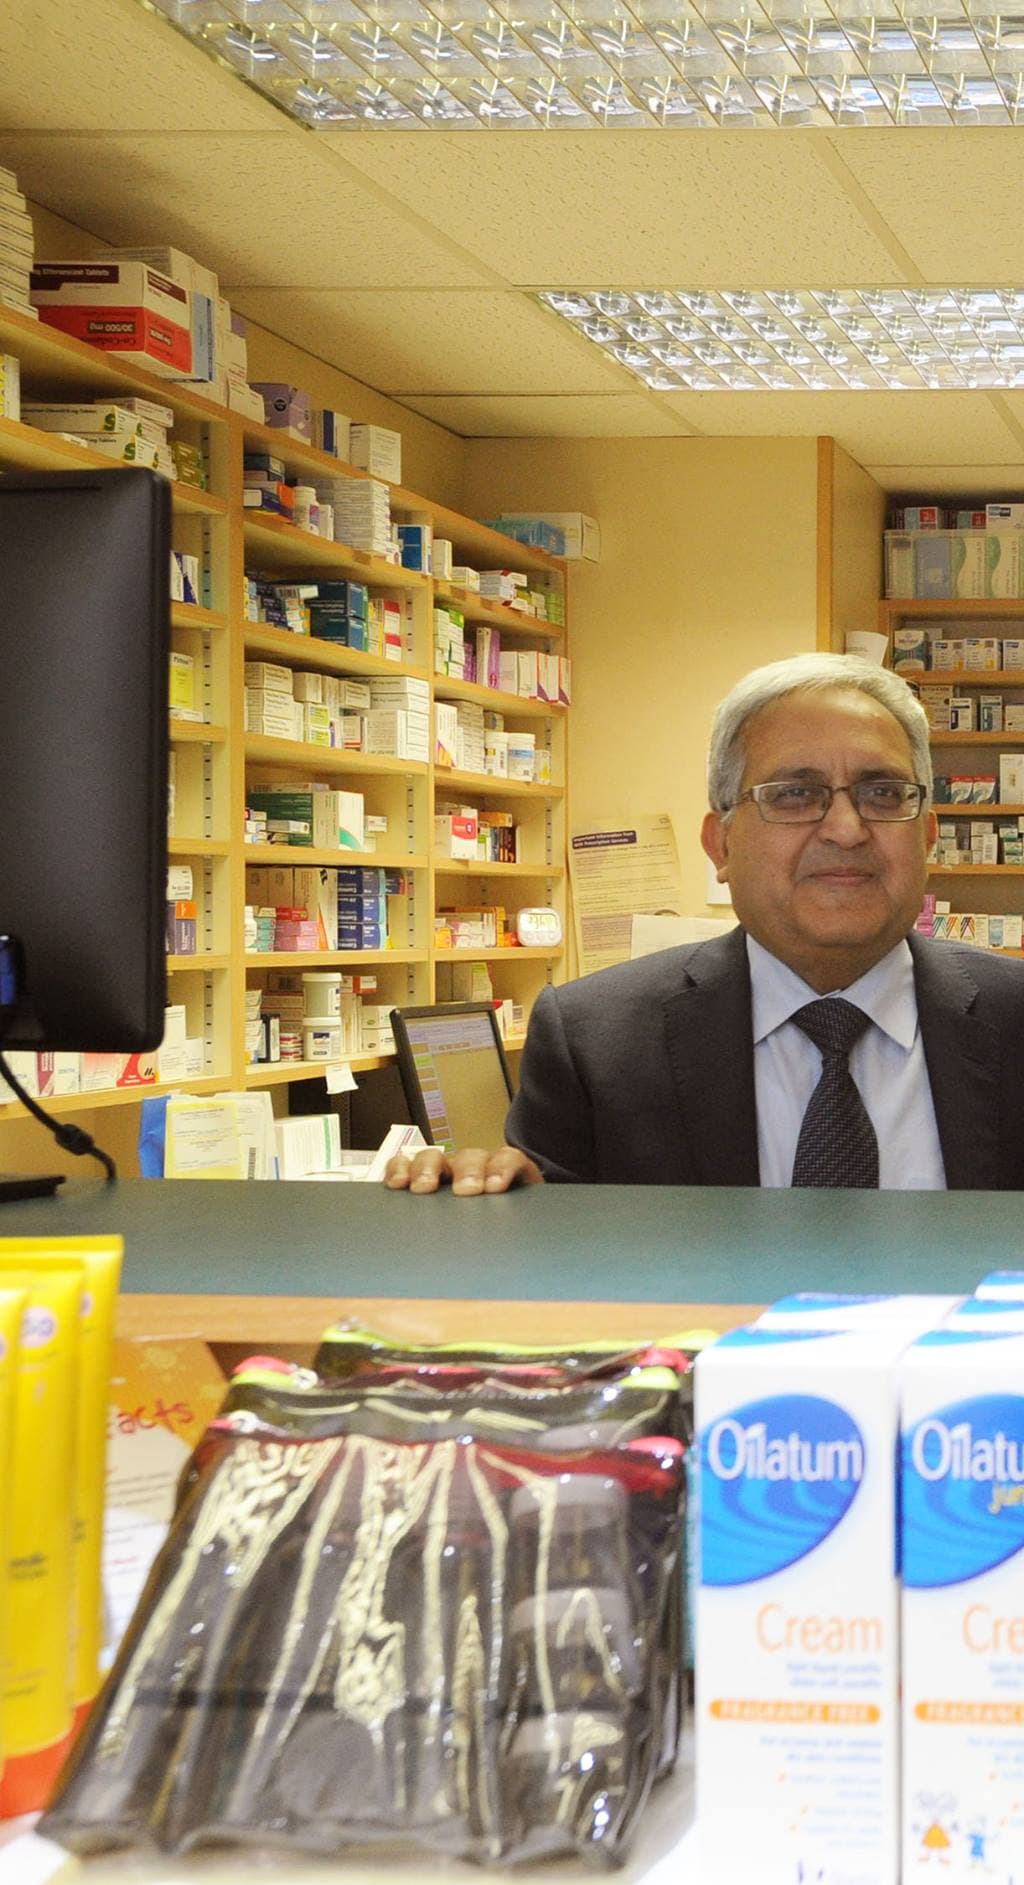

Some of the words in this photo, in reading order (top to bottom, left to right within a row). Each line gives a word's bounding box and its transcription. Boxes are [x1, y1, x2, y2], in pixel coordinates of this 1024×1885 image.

[108, 1397, 195, 1439] acts
[708, 1418, 863, 1481] Oilatum
[756, 1602, 883, 1653] Cream
